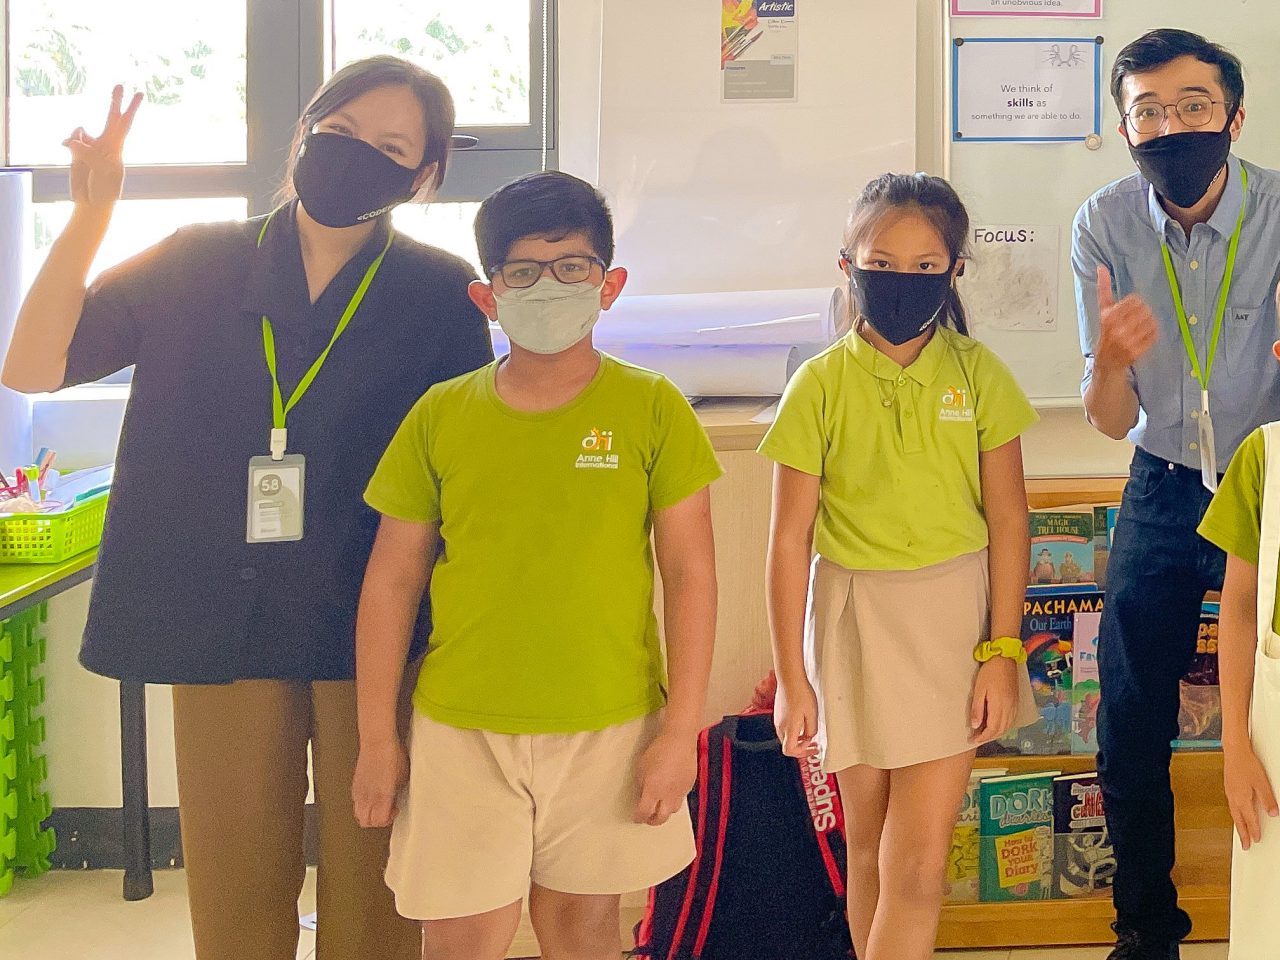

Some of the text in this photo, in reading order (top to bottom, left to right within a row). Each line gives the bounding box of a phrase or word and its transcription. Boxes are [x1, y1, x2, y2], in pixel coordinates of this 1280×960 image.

[758, 1, 794, 12] Artistic
[1000, 84, 1054, 93] We think of
[1007, 98, 1034, 107] skills
[971, 112, 1013, 121] something
[1041, 112, 1058, 120] able
[1059, 112, 1068, 120] to
[1069, 112, 1082, 120] do.
[974, 229, 1035, 244] Focus:
[576, 454, 603, 462] Anne
[1029, 616, 1072, 631] Our Earth
[990, 788, 1053, 819] DORK
